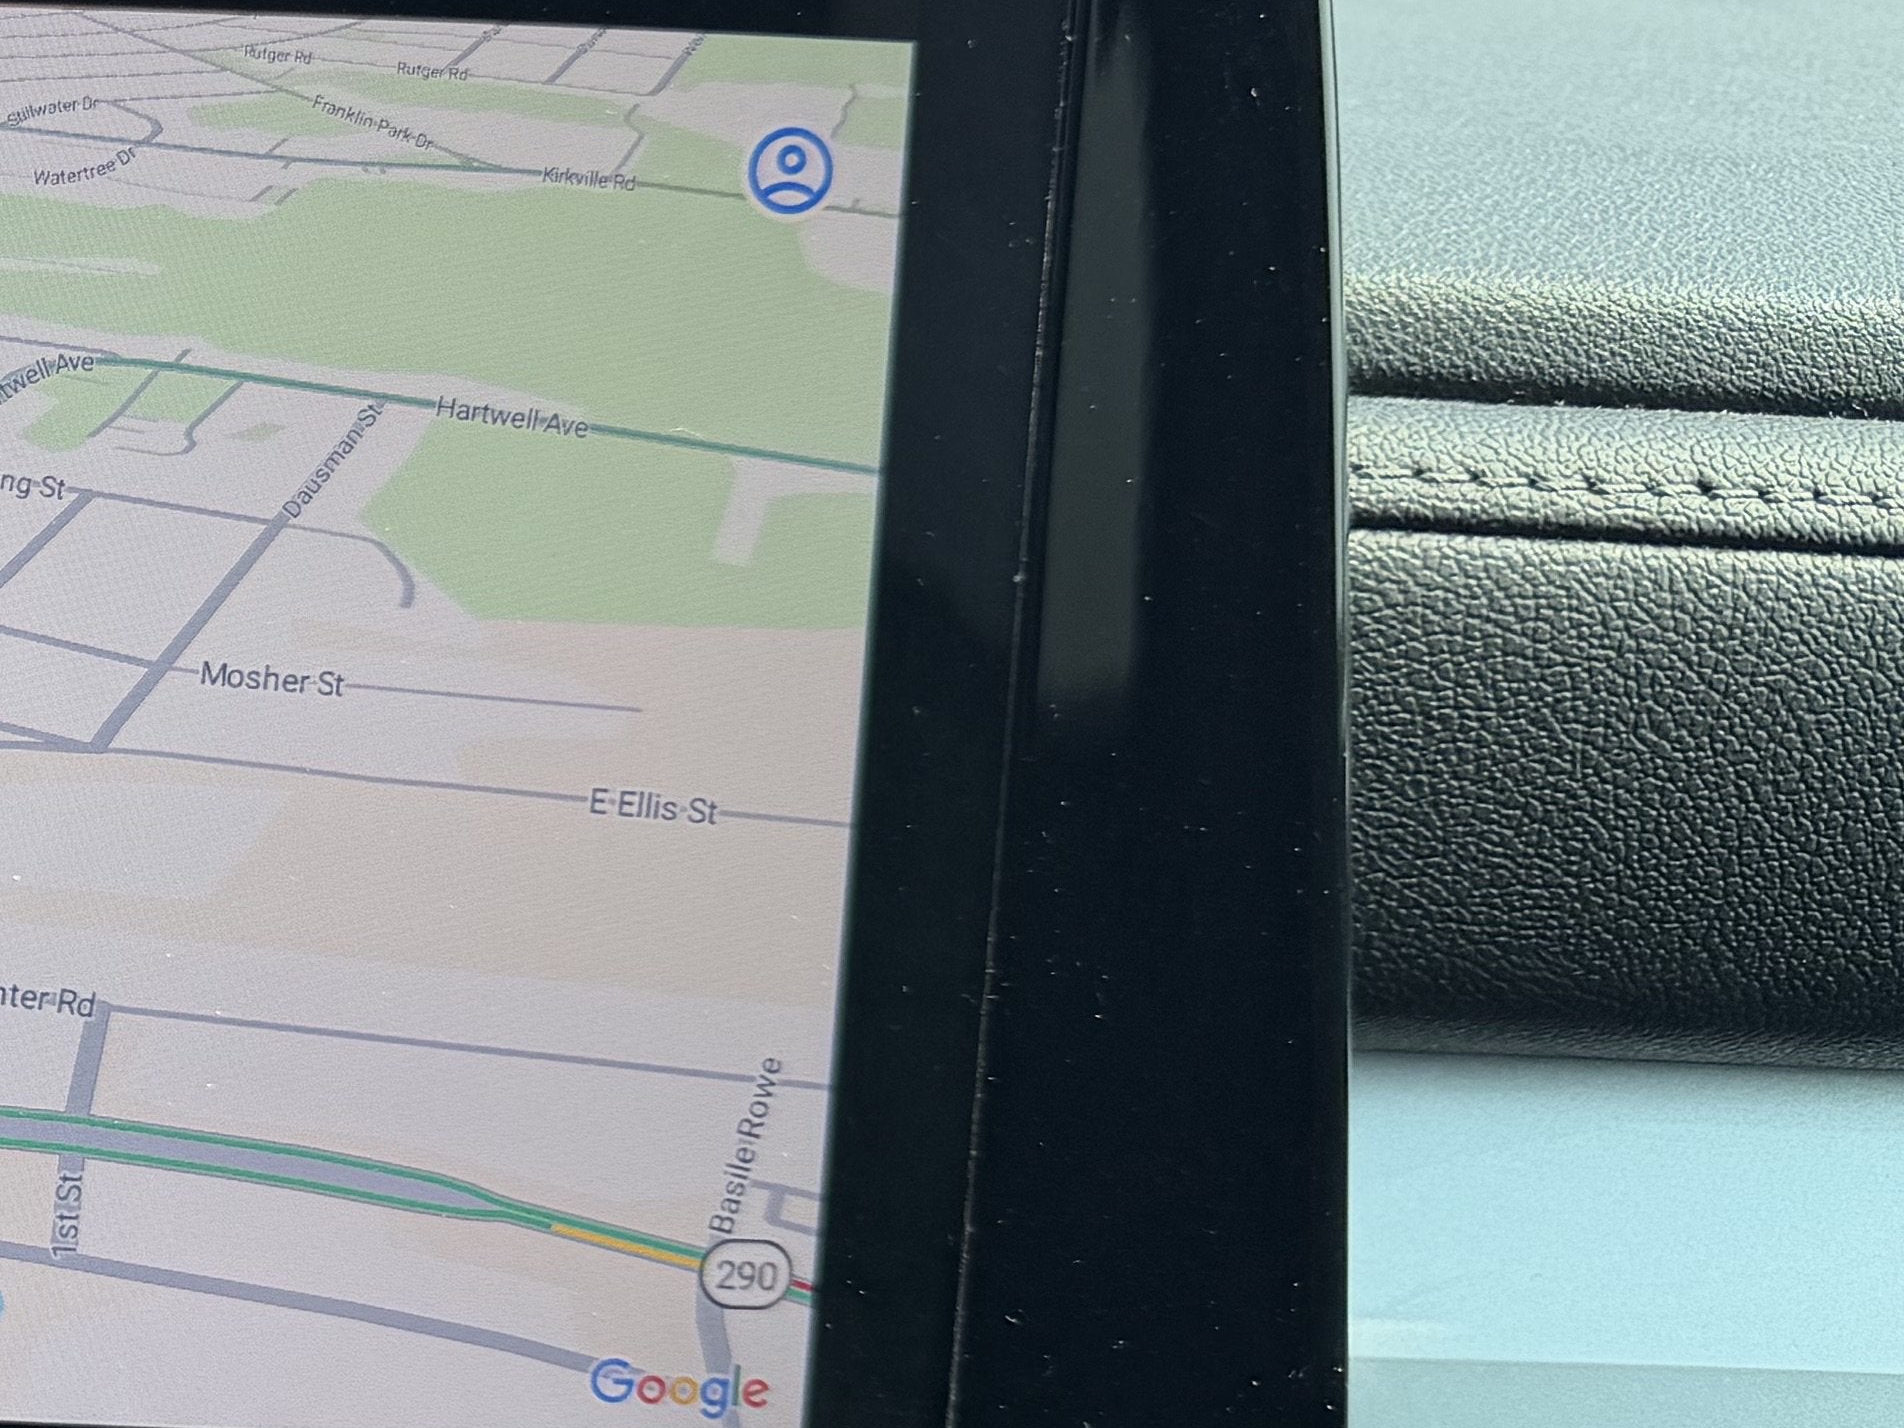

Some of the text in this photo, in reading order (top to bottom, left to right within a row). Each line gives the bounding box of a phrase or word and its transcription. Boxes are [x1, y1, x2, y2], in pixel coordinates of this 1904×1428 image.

[397, 61, 469, 82] Rutger Rd
[312, 95, 435, 151] Franklin Park Dr
[33, 145, 137, 187] Watertree Dr
[543, 167, 636, 191] Kirkville Rd
[54, 353, 95, 374] Ave
[436, 396, 589, 438] Hartwell Ave
[282, 403, 385, 519] Dausman St
[38, 476, 66, 500] St
[201, 661, 344, 696] Mosher St
[589, 788, 718, 826] E Ellis St
[56, 990, 96, 1019] Rd
[709, 1057, 782, 1235] Basile Rowe
[51, 1173, 83, 1259] 1st St
[716, 1260, 778, 1291] 290
[592, 1358, 770, 1420] Google
